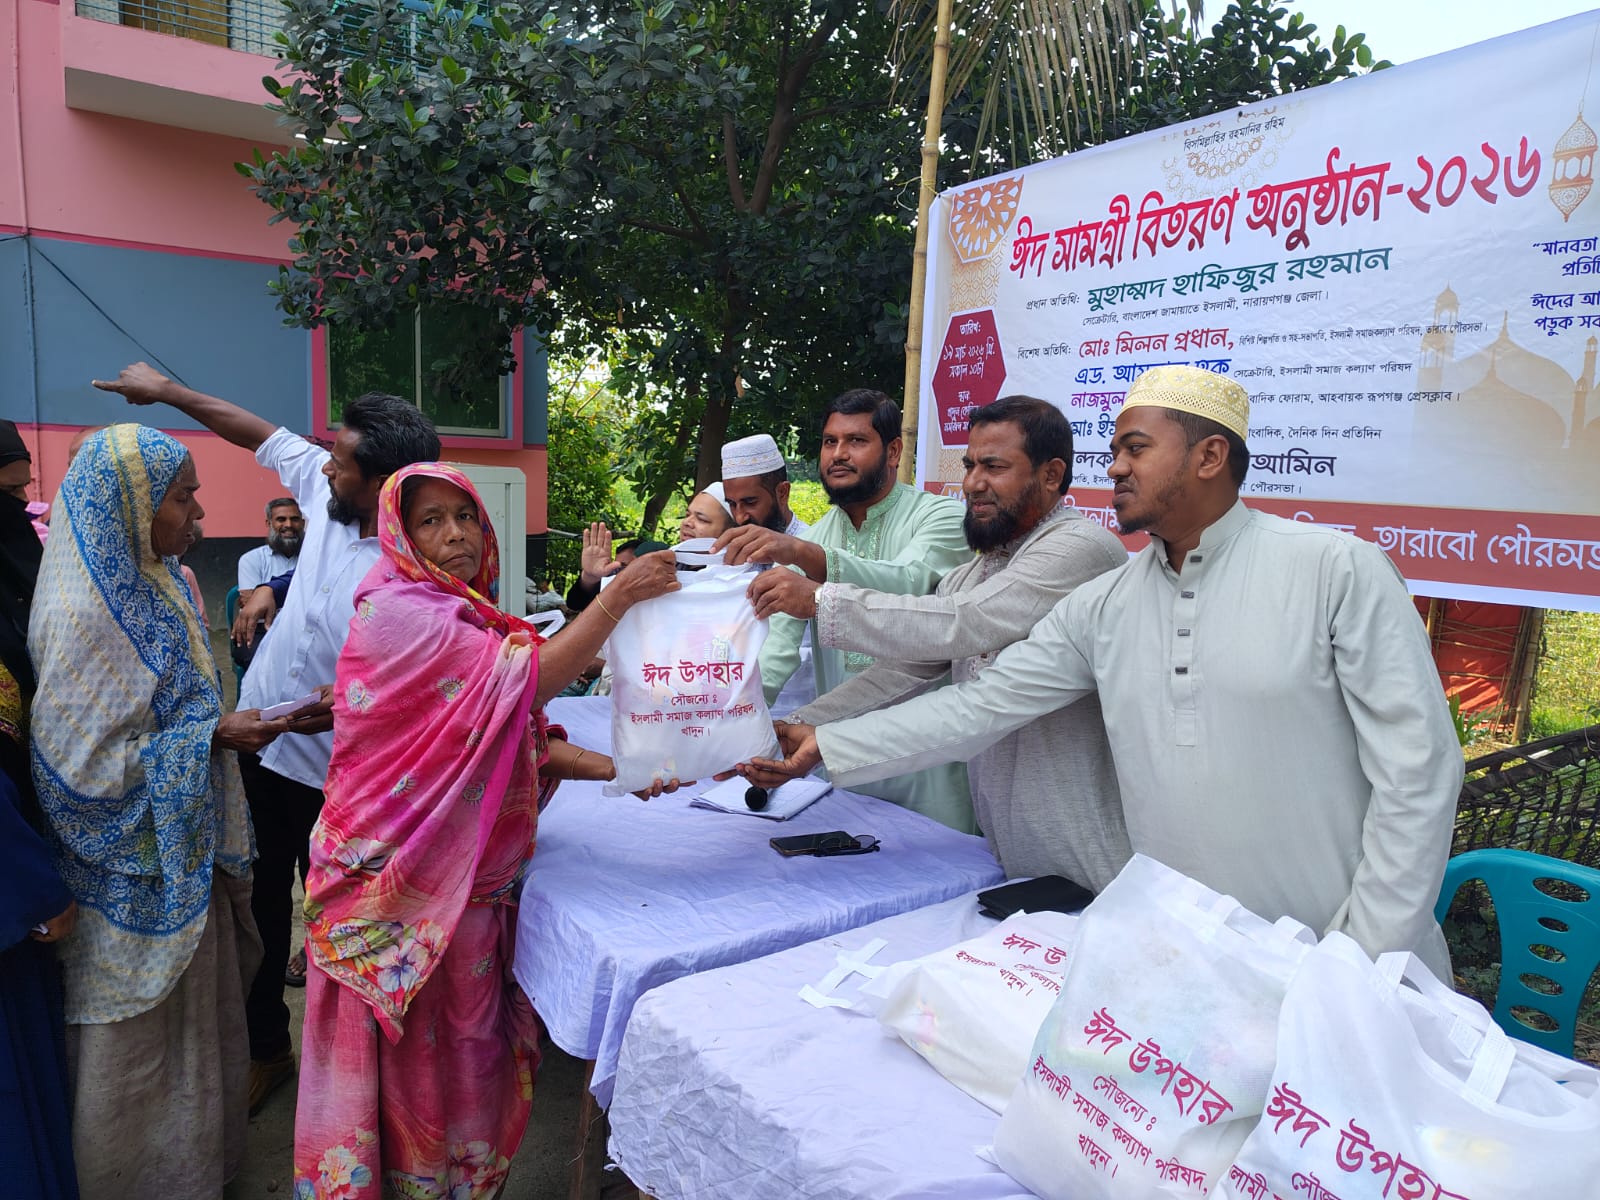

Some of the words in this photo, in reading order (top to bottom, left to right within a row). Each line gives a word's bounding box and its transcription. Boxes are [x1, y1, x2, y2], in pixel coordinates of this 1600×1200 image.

[1229, 122, 1261, 140] রহমানির
[1264, 116, 1286, 130] রহিম
[1009, 216, 1050, 279] ঈদ
[1052, 194, 1130, 272] সামগ্রী
[1133, 187, 1241, 262] বিতরণ
[1026, 298, 1047, 310] প্রধান
[1049, 292, 1080, 307] অতিথি:
[1087, 278, 1167, 312] মুহাম্মদ
[1172, 262, 1279, 296] হাফিজুর
[1286, 247, 1393, 281] রহমান
[1122, 308, 1158, 321] বাংলাদেশ
[1161, 303, 1200, 317] জামায়াতে
[1203, 298, 1238, 312] ইসলামী,
[1243, 293, 1292, 308] নারায়ণগঞ্জ
[1530, 293, 1575, 310] ঈদের
[1534, 316, 1574, 336] পড়ুক
[1018, 348, 1040, 360] বিশেষ
[1042, 343, 1071, 356] অতিথি:
[1116, 330, 1169, 355] মিলন
[1174, 327, 1234, 352] প্রধান,
[1330, 326, 1353, 340] ইসলামী
[949, 364, 968, 381] সকাল
[1075, 367, 1106, 384] এড.
[1234, 366, 1276, 378] সেক্রেটারি,
[1279, 364, 1313, 376] ইসলামী
[1315, 365, 1342, 375] সমাজ
[1345, 363, 1375, 374] কল্যাণ
[1379, 361, 1412, 373] পরিষদ
[1278, 393, 1314, 404] ফোরাম,
[1367, 391, 1402, 402] রূপগঞ্জ
[1288, 425, 1318, 439] দৈনিক
[1322, 426, 1339, 439] দিন
[1341, 426, 1382, 440] প্রতিদিন
[1251, 447, 1337, 477] আমিন
[1372, 525, 1477, 562] তারাবো
[642, 661, 673, 688] ঈদ
[678, 659, 744, 686] উপহার
[630, 709, 664, 725] ইসলামী
[666, 711, 692, 722] সমাজ
[695, 708, 725, 720] কল্যাণ
[727, 703, 757, 718] পরিষদ,
[1003, 933, 1042, 955] ঈদ
[1084, 1007, 1132, 1055] ঈদ
[1129, 1037, 1234, 1125] উপহার
[1033, 1054, 1072, 1101] ইসলামী
[1073, 1092, 1110, 1131] সমাজ
[1112, 1122, 1152, 1165] কল্যাণ
[1155, 1157, 1208, 1195] পরিষদ,
[1267, 1082, 1331, 1149] ঈদ
